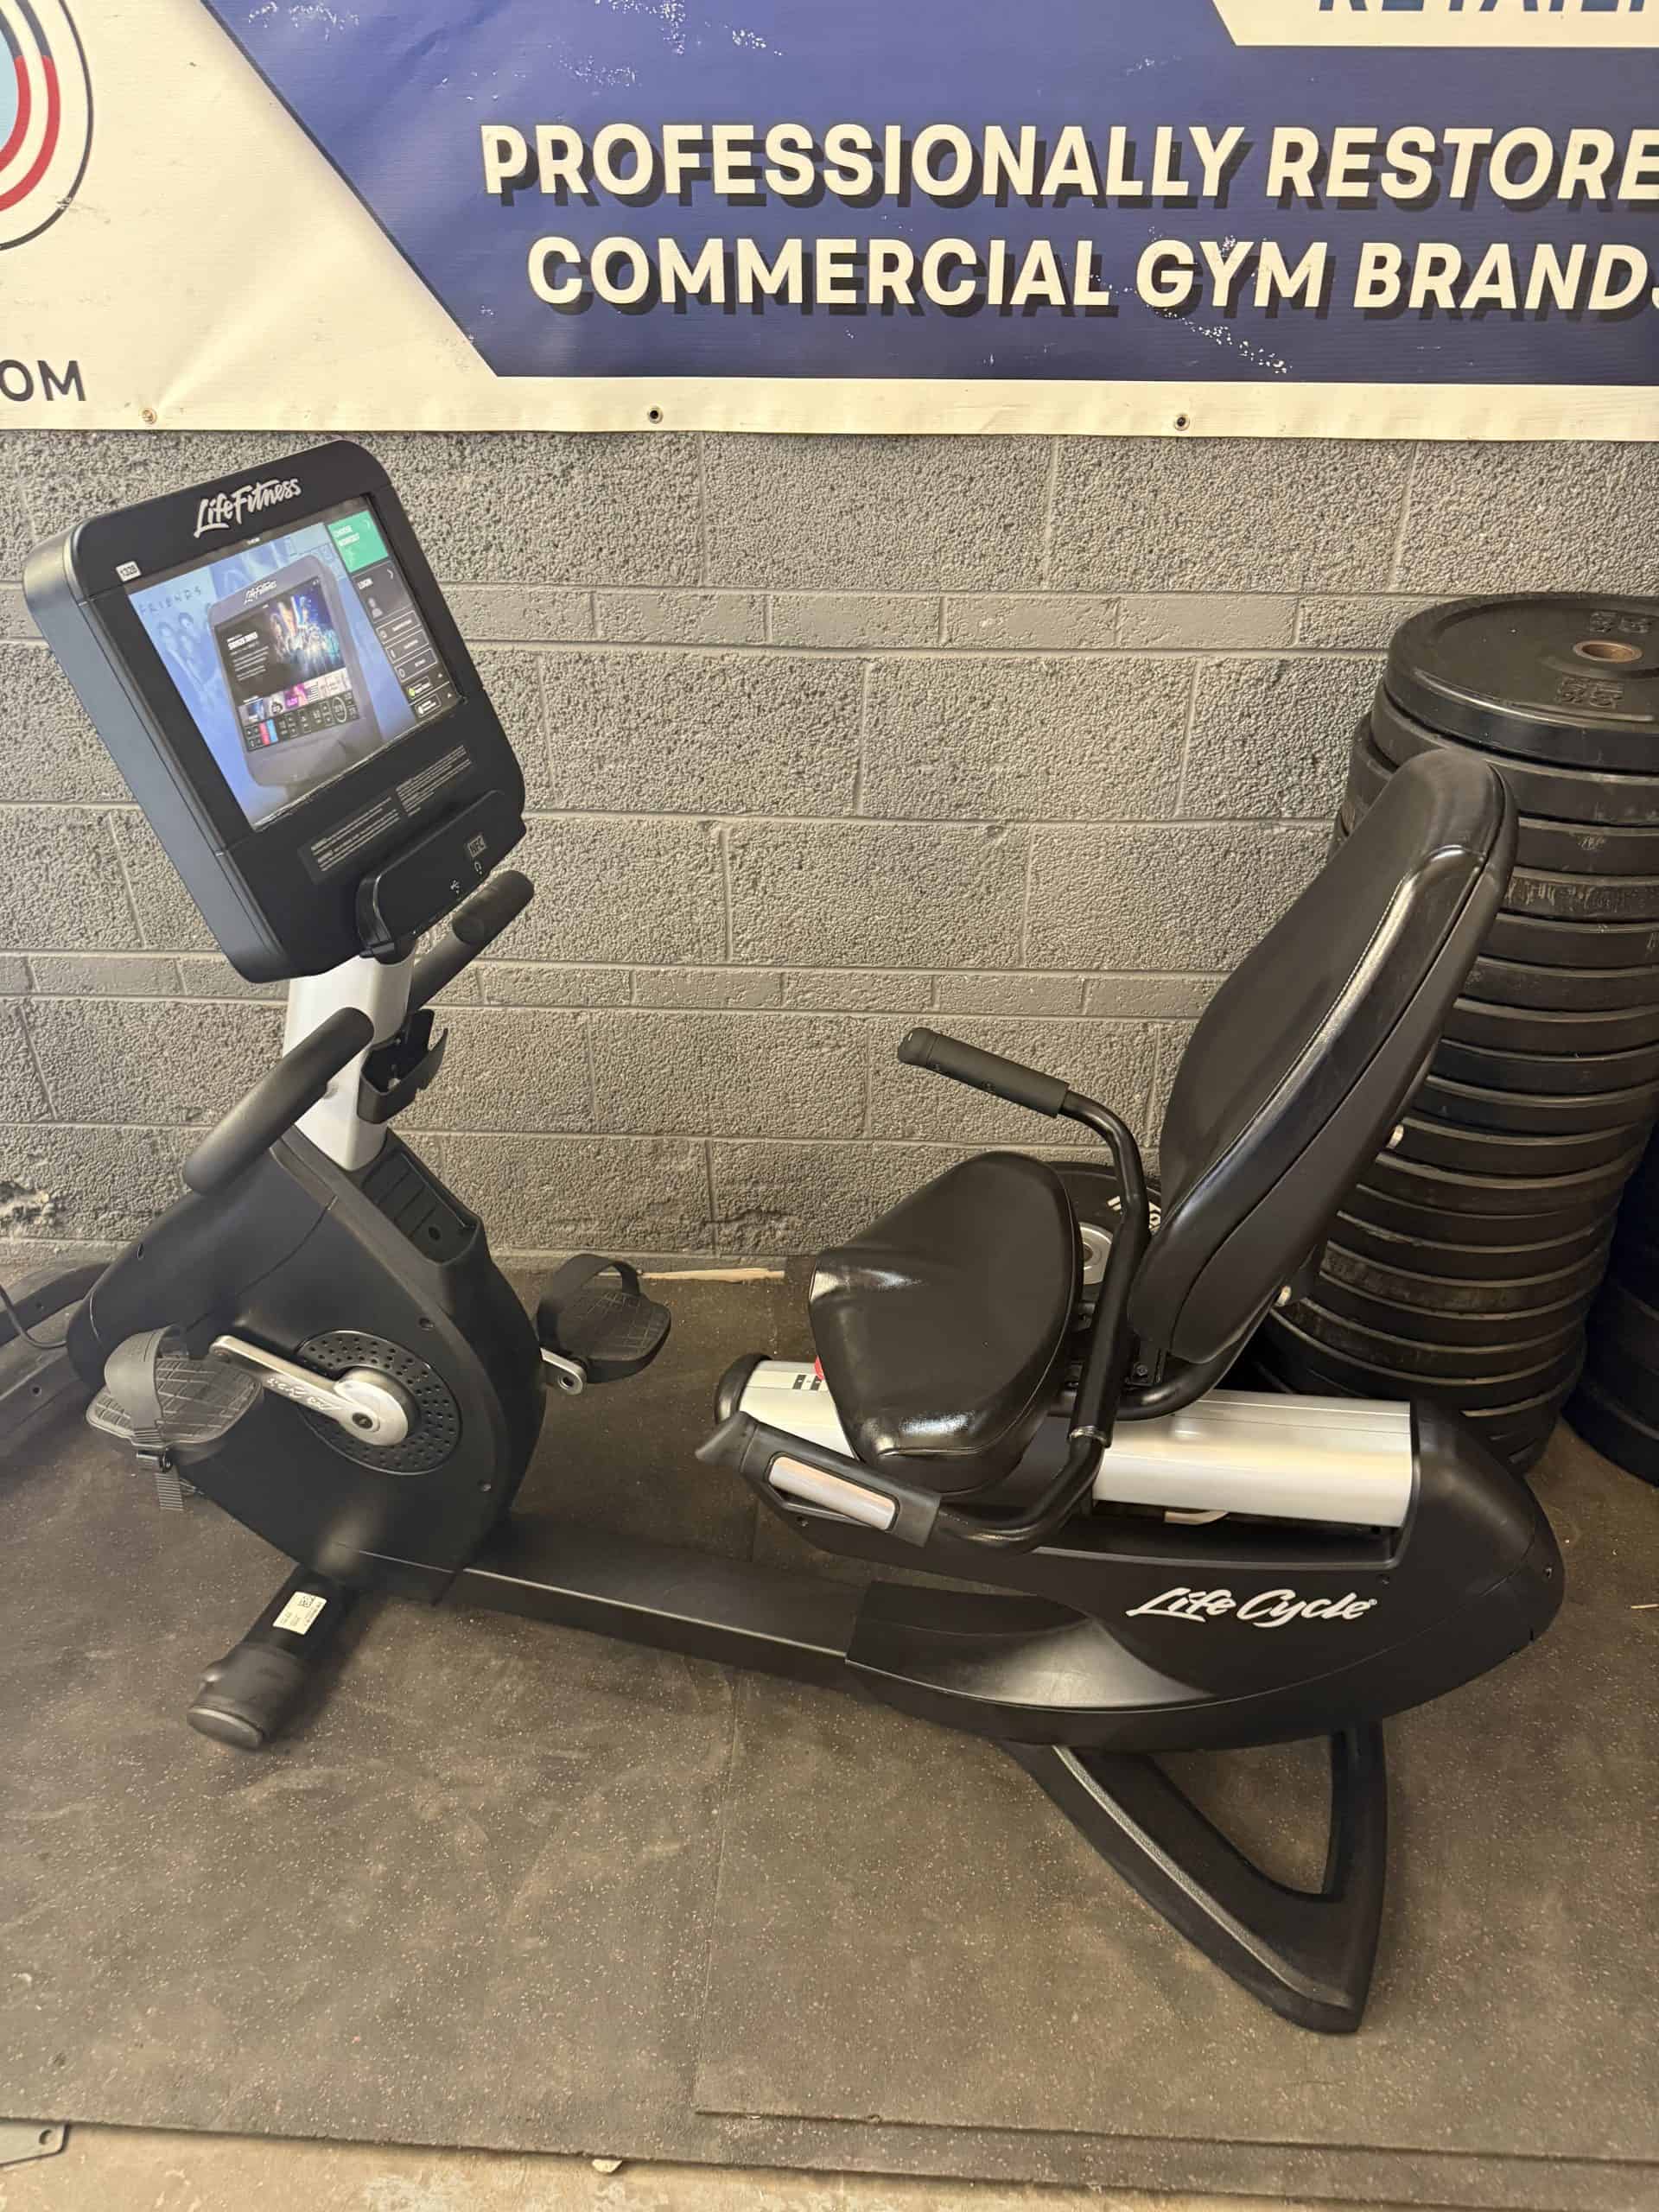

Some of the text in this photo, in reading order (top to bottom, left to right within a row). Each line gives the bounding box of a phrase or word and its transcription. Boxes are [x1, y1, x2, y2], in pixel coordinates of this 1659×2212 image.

[480, 123, 1659, 200] PROFESSIONALLY RESTORE
[528, 236, 1659, 310] COMMERCIAL GYM BRAND
